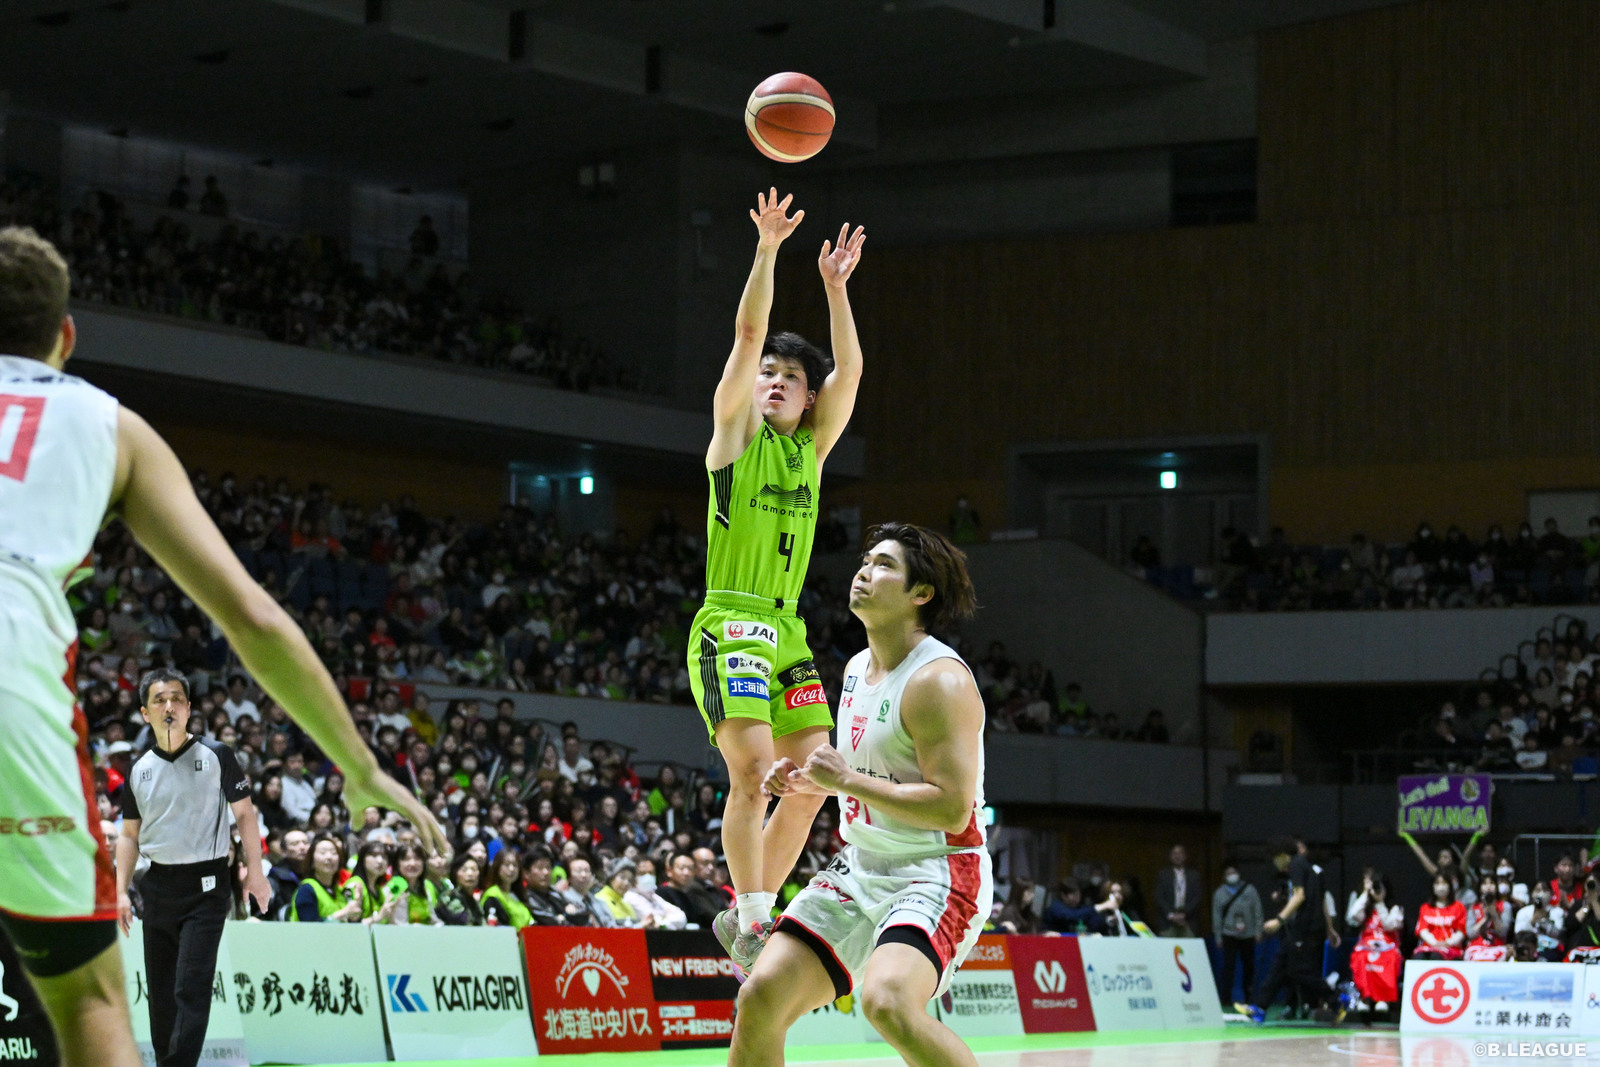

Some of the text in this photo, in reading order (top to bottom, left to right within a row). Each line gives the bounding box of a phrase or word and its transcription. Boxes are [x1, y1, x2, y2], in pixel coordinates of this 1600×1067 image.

[778, 532, 795, 572] 4
[747, 626, 775, 643] JAL
[846, 796, 871, 825] 31
[1398, 805, 1488, 830] LEVANGA
[651, 958, 683, 976] NEW
[432, 974, 523, 1012] KATAGIRI
[543, 1006, 653, 1040] 北海道中央バス
